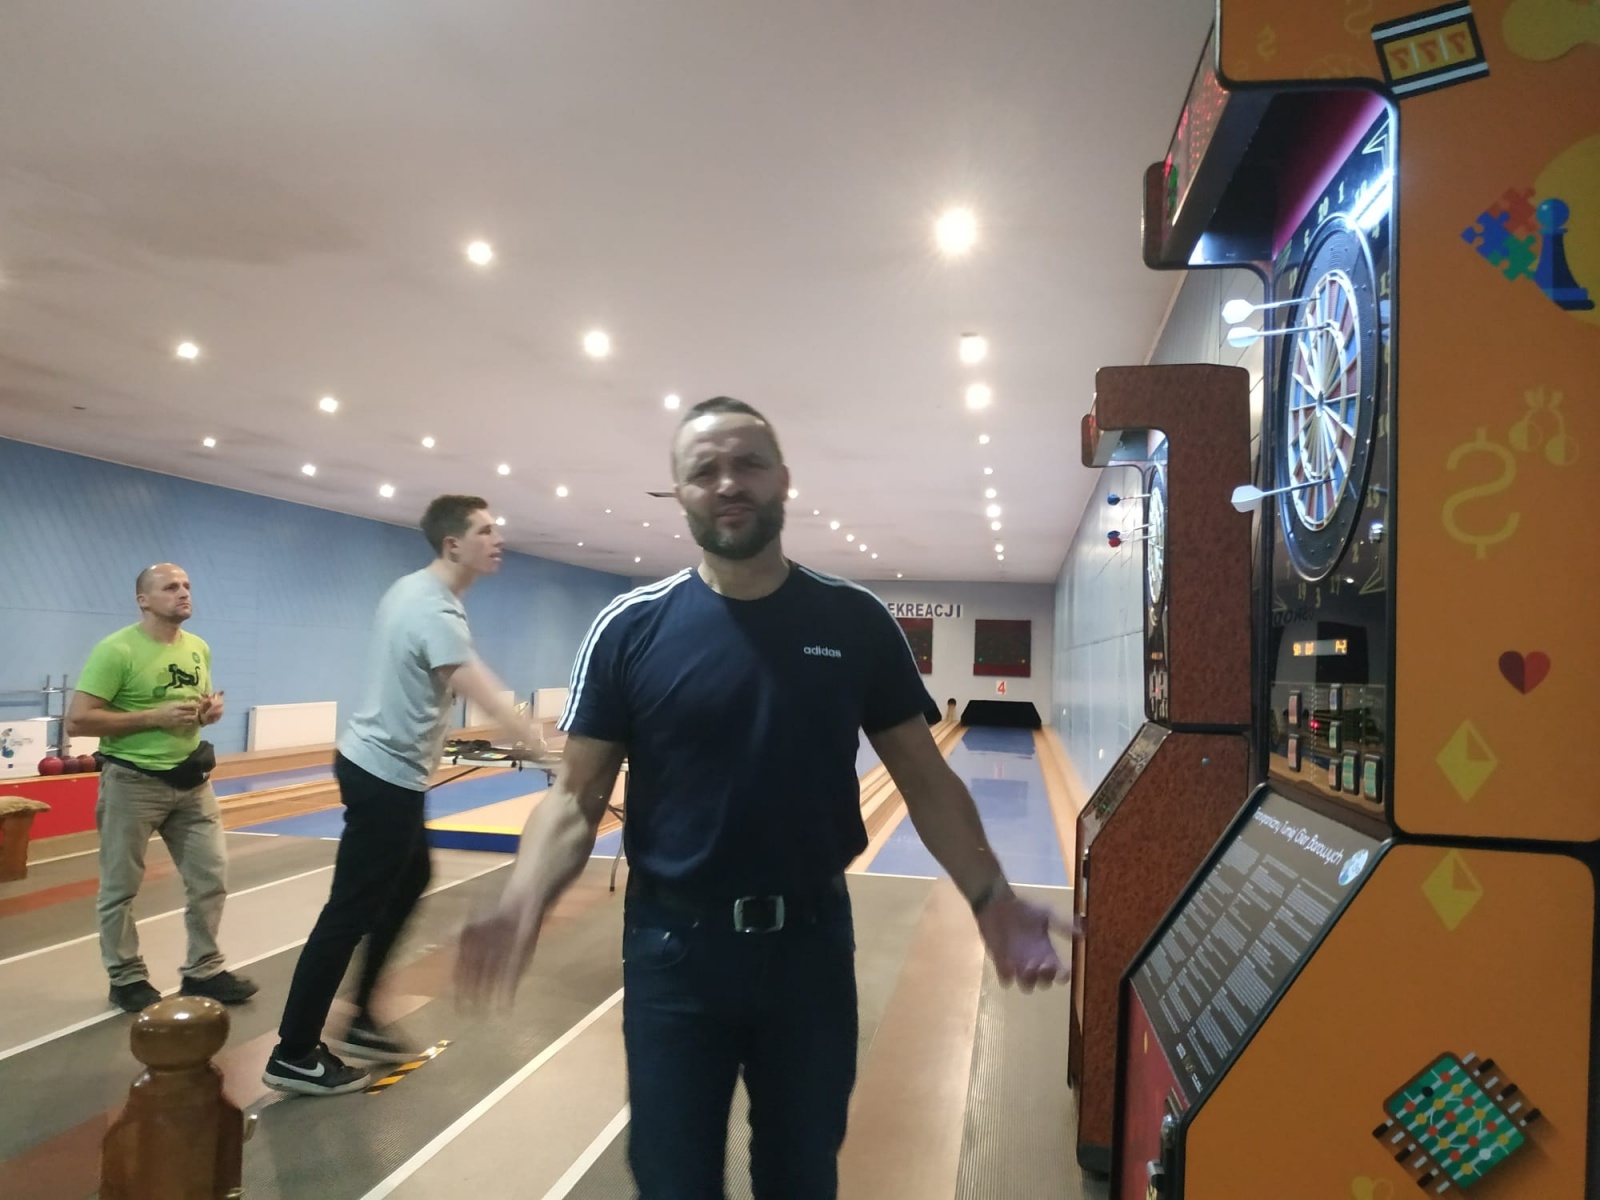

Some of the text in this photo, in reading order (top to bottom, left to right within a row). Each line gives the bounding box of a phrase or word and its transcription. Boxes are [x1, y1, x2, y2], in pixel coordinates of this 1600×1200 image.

[803, 645, 842, 659] adidas
[997, 681, 1006, 695] 4
[1294, 828, 1310, 847] Gier
[1303, 834, 1344, 866] Barowych
